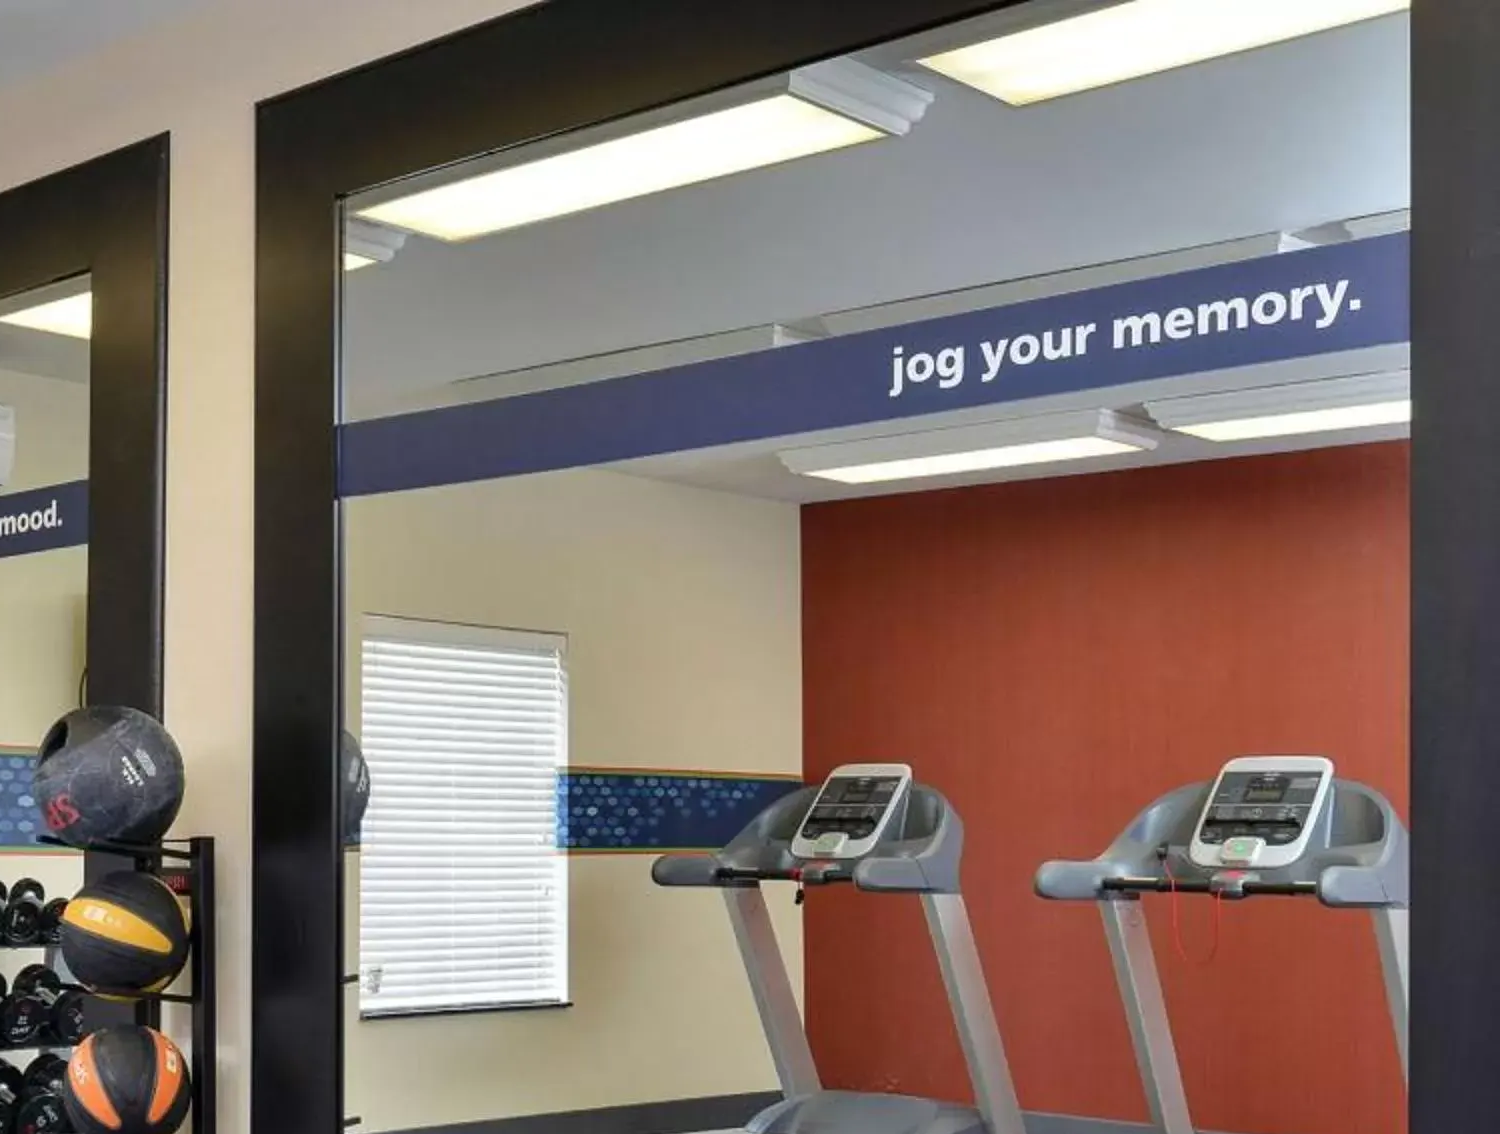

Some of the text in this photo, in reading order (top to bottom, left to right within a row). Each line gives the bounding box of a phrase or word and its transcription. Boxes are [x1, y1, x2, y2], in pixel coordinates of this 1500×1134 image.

[888, 279, 1362, 397] jog your memory.
